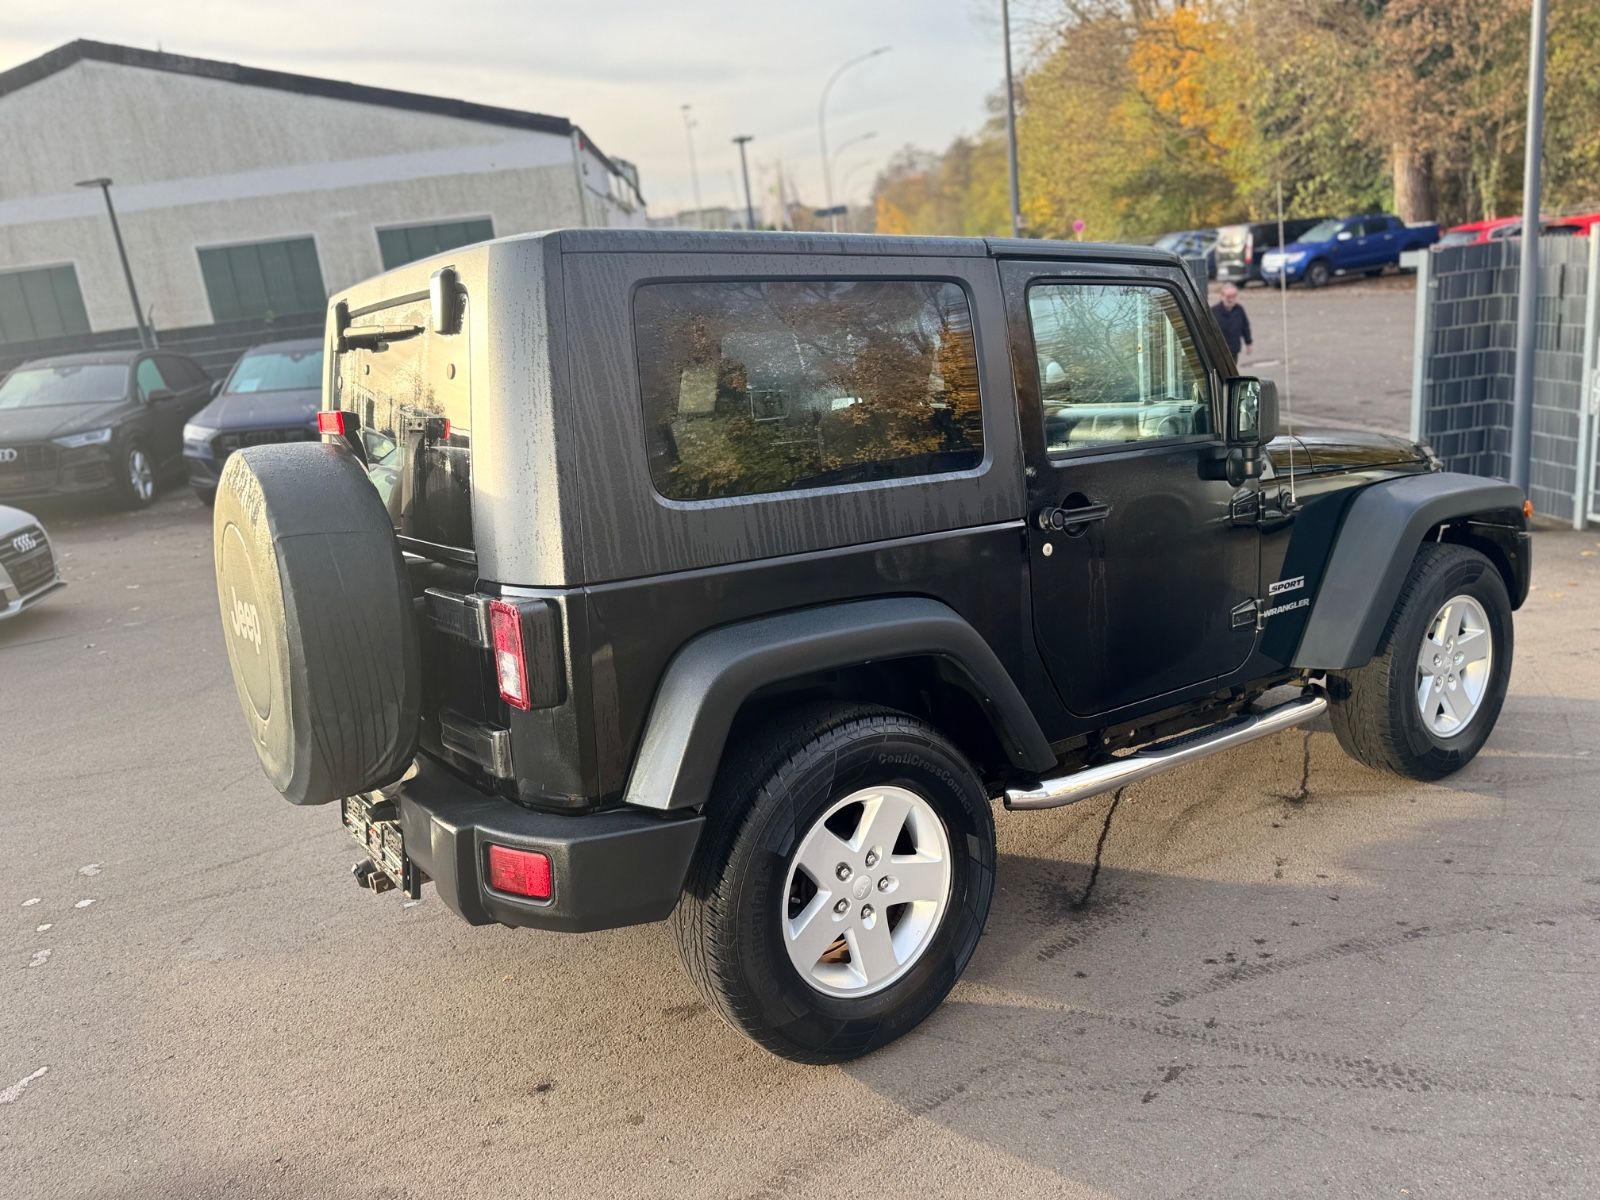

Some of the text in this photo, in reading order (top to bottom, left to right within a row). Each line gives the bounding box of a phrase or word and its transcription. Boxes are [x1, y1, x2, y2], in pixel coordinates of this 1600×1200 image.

[1270, 579, 1303, 593] SPORT
[1263, 598, 1310, 618] WRANGLER
[230, 586, 262, 655] Jeep
